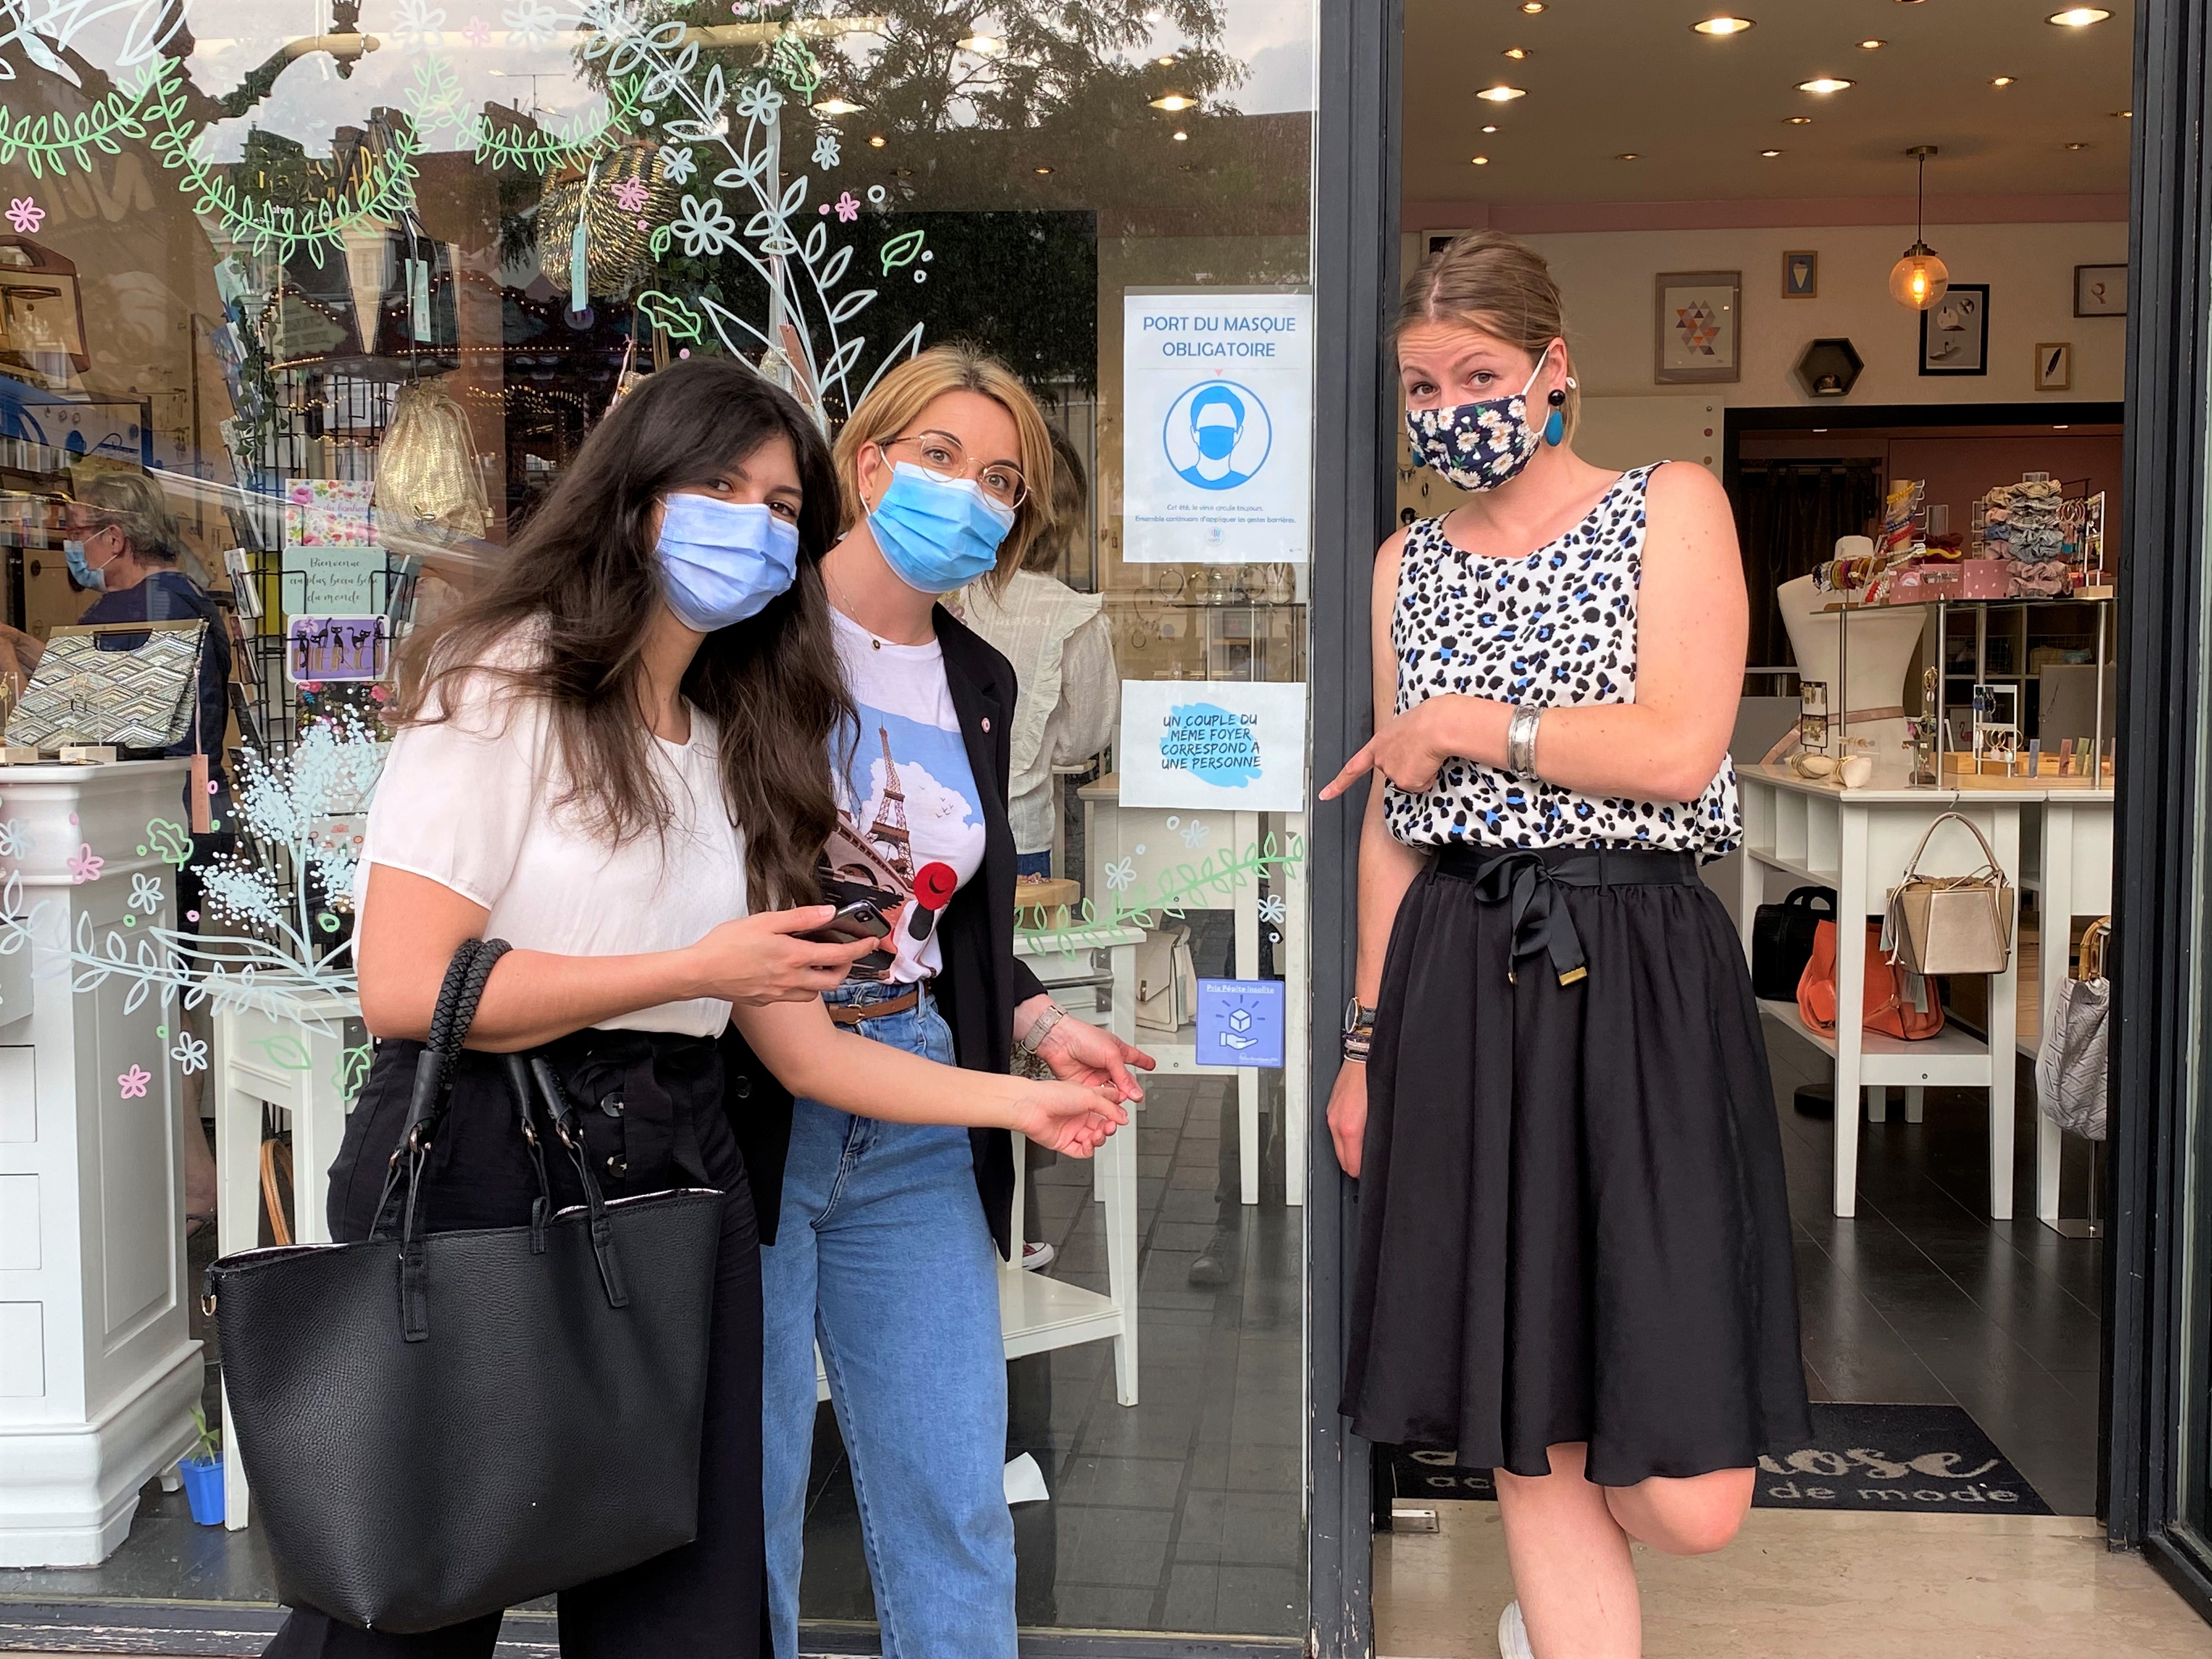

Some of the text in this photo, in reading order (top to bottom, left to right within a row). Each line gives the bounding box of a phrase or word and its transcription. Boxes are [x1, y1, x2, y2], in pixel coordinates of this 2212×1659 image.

[1143, 317, 1296, 334] PORT DU MASQUE
[1162, 342, 1275, 357] OBLIGATOIRE
[310, 557, 360, 567] Bienvenue
[330, 573, 353, 586] beau
[307, 590, 360, 603] du monde
[1163, 714, 1257, 727] UN COUPLE DU
[1171, 726, 1251, 741] MÊME FOYER
[1161, 742, 1246, 756] CORRESPOND
[1161, 756, 1261, 770] UNE PERSONNE
[1769, 1481, 2019, 1503] de mode
